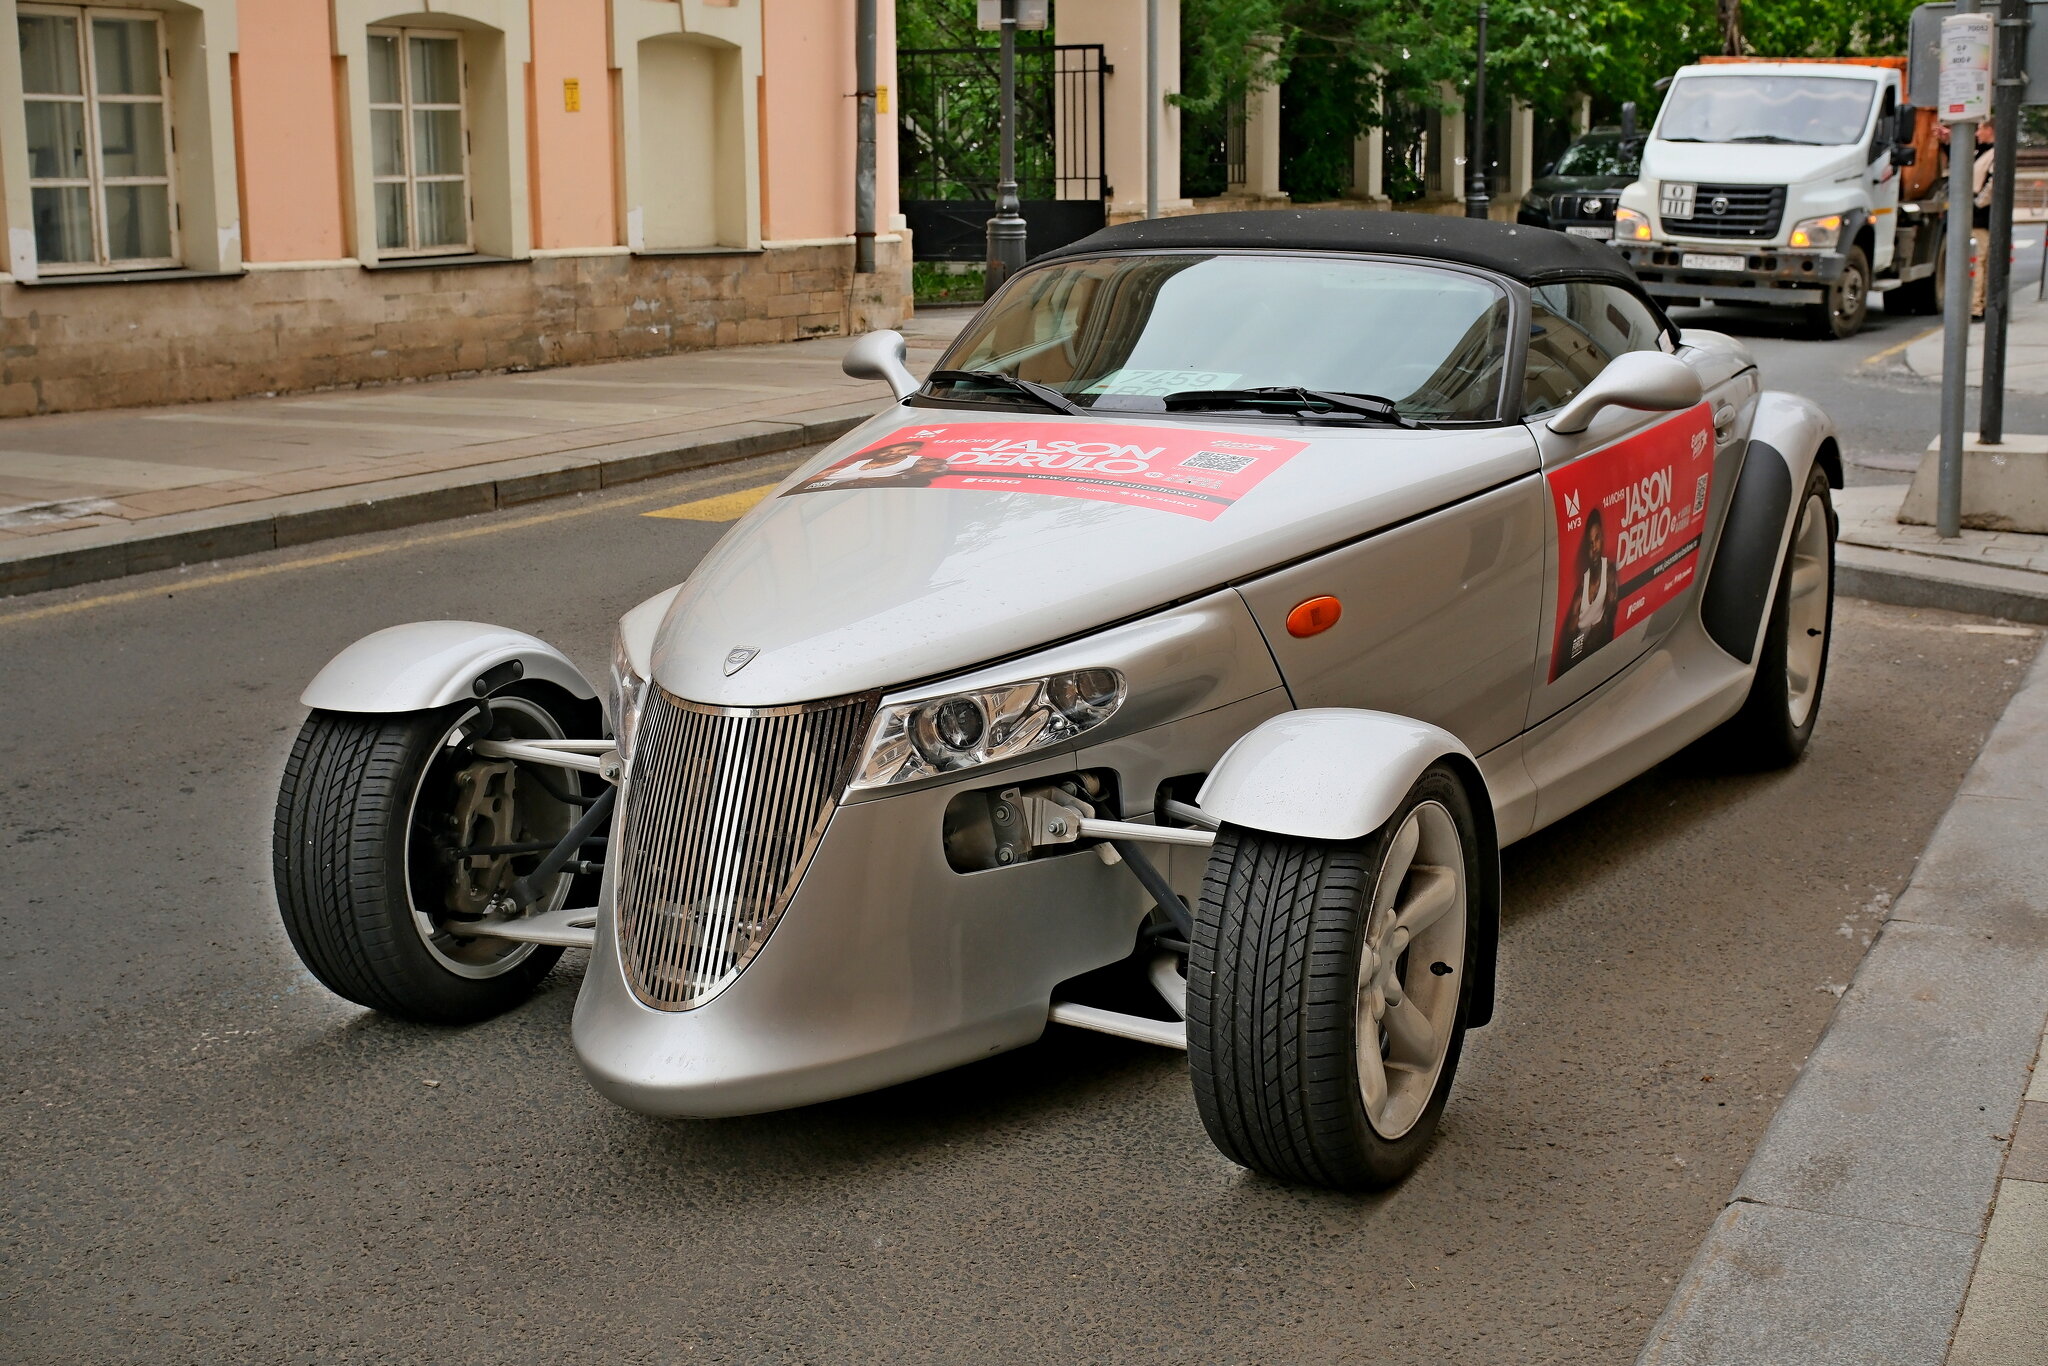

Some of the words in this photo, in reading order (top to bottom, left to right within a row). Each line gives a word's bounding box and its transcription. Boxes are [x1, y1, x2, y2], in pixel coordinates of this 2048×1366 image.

[1119, 371, 1219, 387] 7459
[971, 439, 1167, 460] JASON
[946, 451, 1150, 474] DERULO
[1027, 473, 1209, 500] www.jasonderuloshow.ru
[1602, 496, 1609, 508] 14
[1608, 488, 1625, 506] ИЮНЯ
[1620, 465, 1672, 528] JASON
[1616, 506, 1671, 571] DERULO
